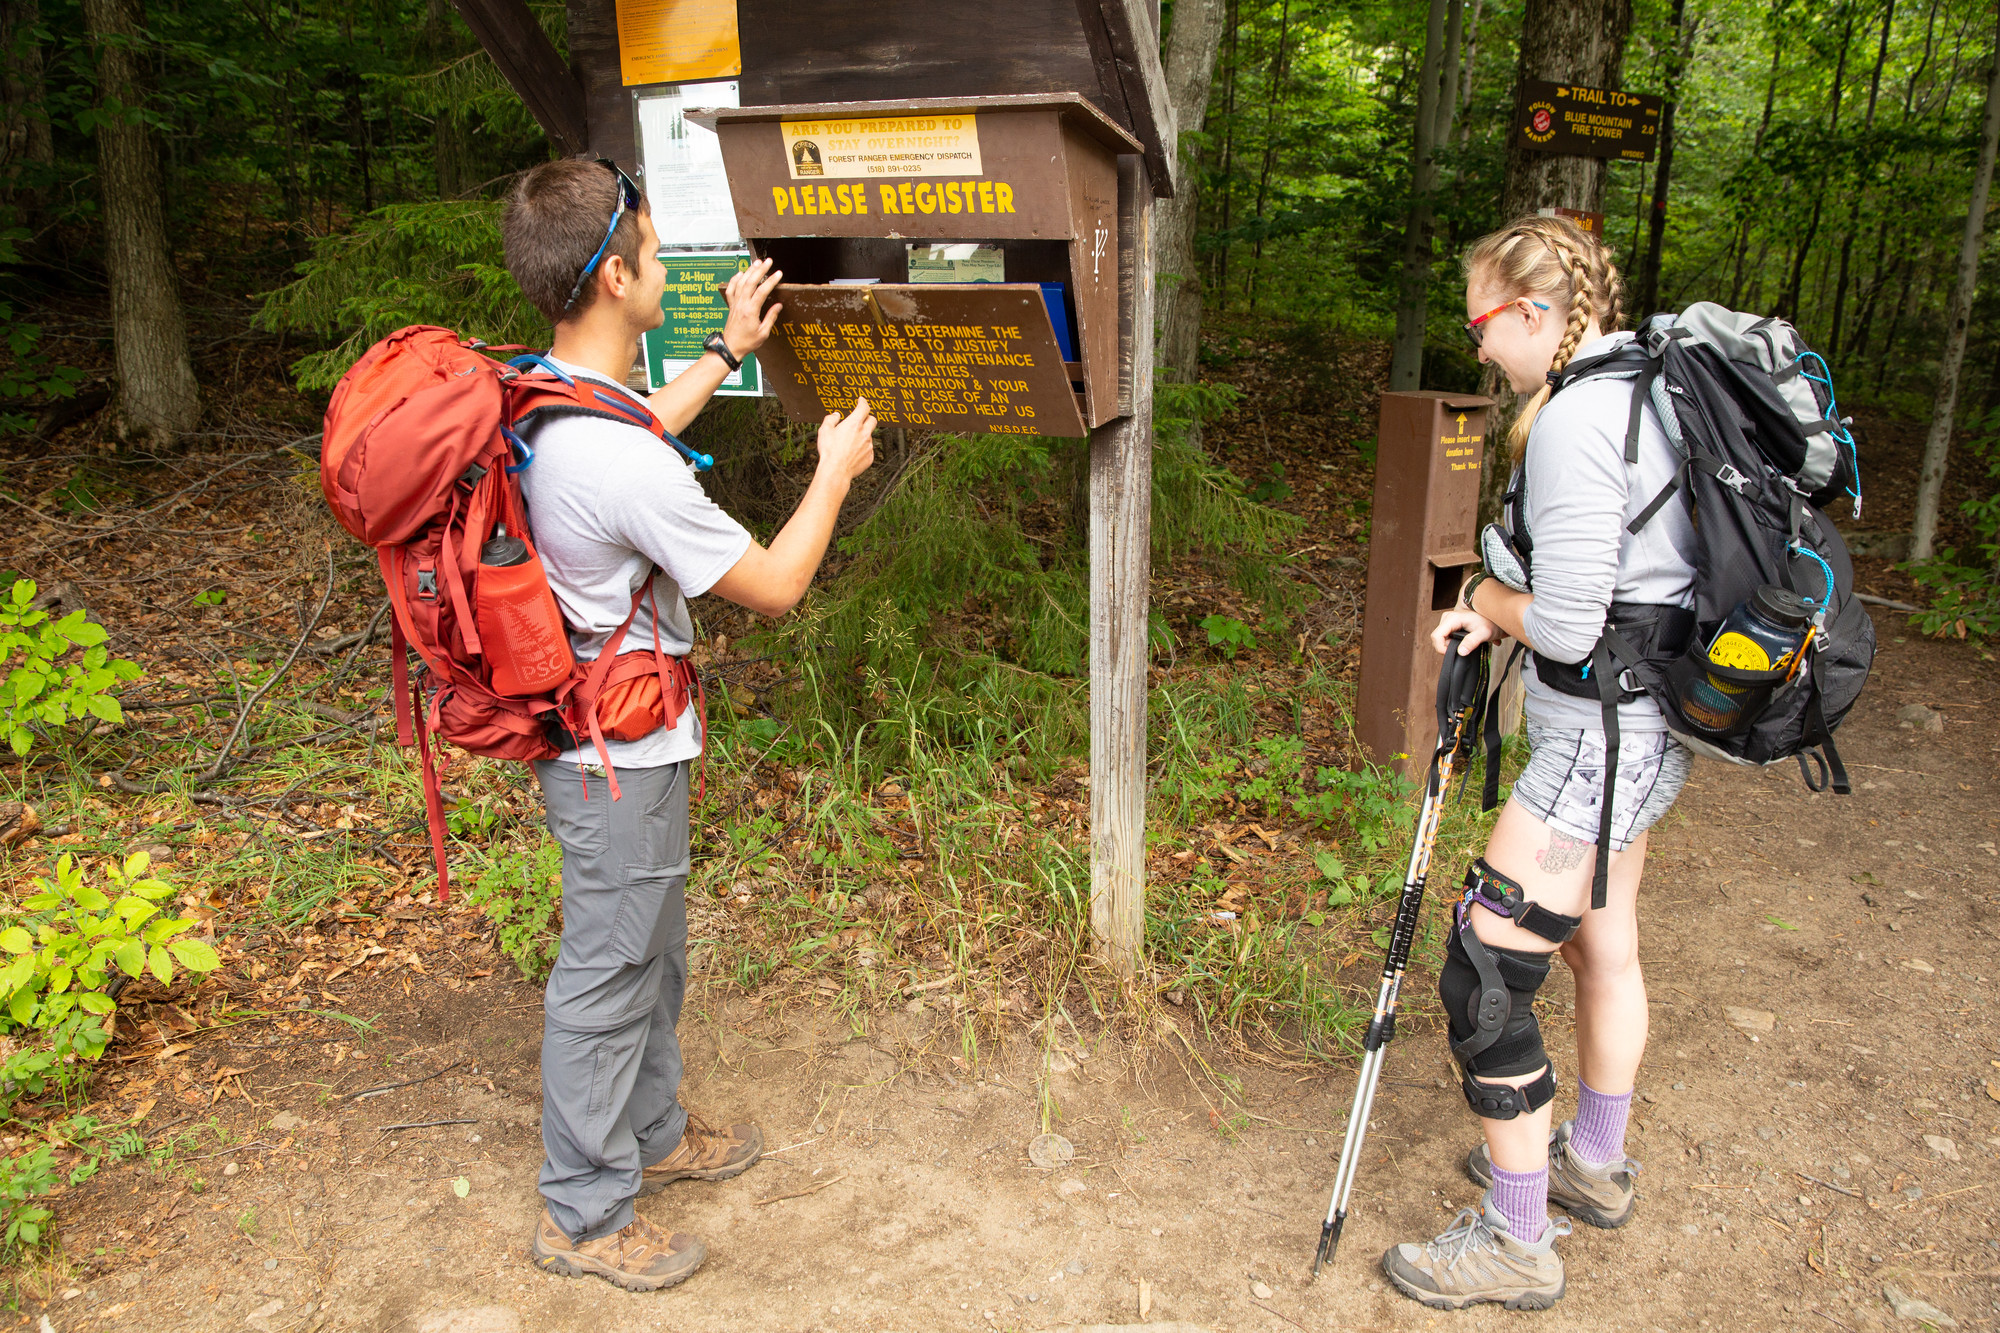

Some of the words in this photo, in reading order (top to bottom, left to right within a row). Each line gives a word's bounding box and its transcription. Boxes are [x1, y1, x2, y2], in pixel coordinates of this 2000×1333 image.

[1572, 87, 1607, 104] TRAIL
[1610, 92, 1627, 106] TO
[1528, 101, 1556, 114] FOLLOW
[792, 124, 820, 136] ARE
[824, 122, 852, 134] YOU
[859, 119, 936, 133] PREPARED
[942, 118, 962, 130] TO
[1564, 111, 1586, 124] BLUE
[1588, 115, 1632, 129] MOUNTAIN
[1524, 126, 1556, 142] MARKERS
[1572, 124, 1590, 136] FIRE
[1593, 126, 1622, 139] TOWER
[1642, 125, 1654, 135] 2.0
[794, 142, 816, 152] FOREST
[828, 139, 860, 151] STAY
[867, 136, 960, 150] OVERNIGHT?
[890, 153, 934, 161] EMERGENCY
[1622, 150, 1645, 159] NYSDEC
[867, 166, 884, 174] (518)
[888, 164, 922, 172] 891-0235
[772, 183, 868, 216] PLEASE
[879, 181, 1016, 214] REGISTER
[680, 272, 715, 282] 24-Hour
[680, 294, 714, 304] Number
[783, 324, 795, 335] IT
[801, 324, 835, 336] WILL
[838, 324, 871, 336] HELP
[878, 324, 899, 337] US
[904, 325, 986, 339] DETERMINE
[991, 326, 1022, 339] THE
[788, 336, 816, 348] USE
[820, 337, 838, 348] OF
[843, 337, 874, 350] THIS
[882, 338, 920, 350] AREA
[924, 338, 944, 351] TO
[953, 340, 1008, 352] JUSTIFY
[795, 348, 892, 363] EXPENDITURES
[897, 352, 926, 364] FOR
[932, 352, 1034, 366] MAINTENANCE
[802, 362, 812, 372] &
[818, 362, 895, 375] ADDITIONAL
[900, 364, 974, 378] FACILITIES.
[794, 372, 808, 384] 2)
[812, 374, 840, 386] FOR
[844, 375, 874, 386] OUR
[878, 376, 967, 390] INFORMATION
[974, 379, 984, 390] &
[989, 380, 1029, 392] YOUR
[900, 389, 916, 400] IN
[920, 390, 958, 402] CASE
[963, 391, 980, 402] OF
[990, 392, 1010, 404] AN
[902, 401, 914, 412] IT
[922, 402, 968, 414] COULD
[974, 404, 1008, 416] HELP
[1014, 406, 1036, 418] US
[903, 412, 936, 424] YOU.
[989, 424, 1040, 434] N.Y.S.D.E.C.
[1440, 436, 1456, 444] Please
[1457, 435, 1470, 444] insert
[1471, 436, 1482, 444] your
[1446, 448, 1464, 457] donation
[1464, 447, 1474, 456] here
[1451, 462, 1466, 471] Thank
[1468, 462, 1477, 470] You
